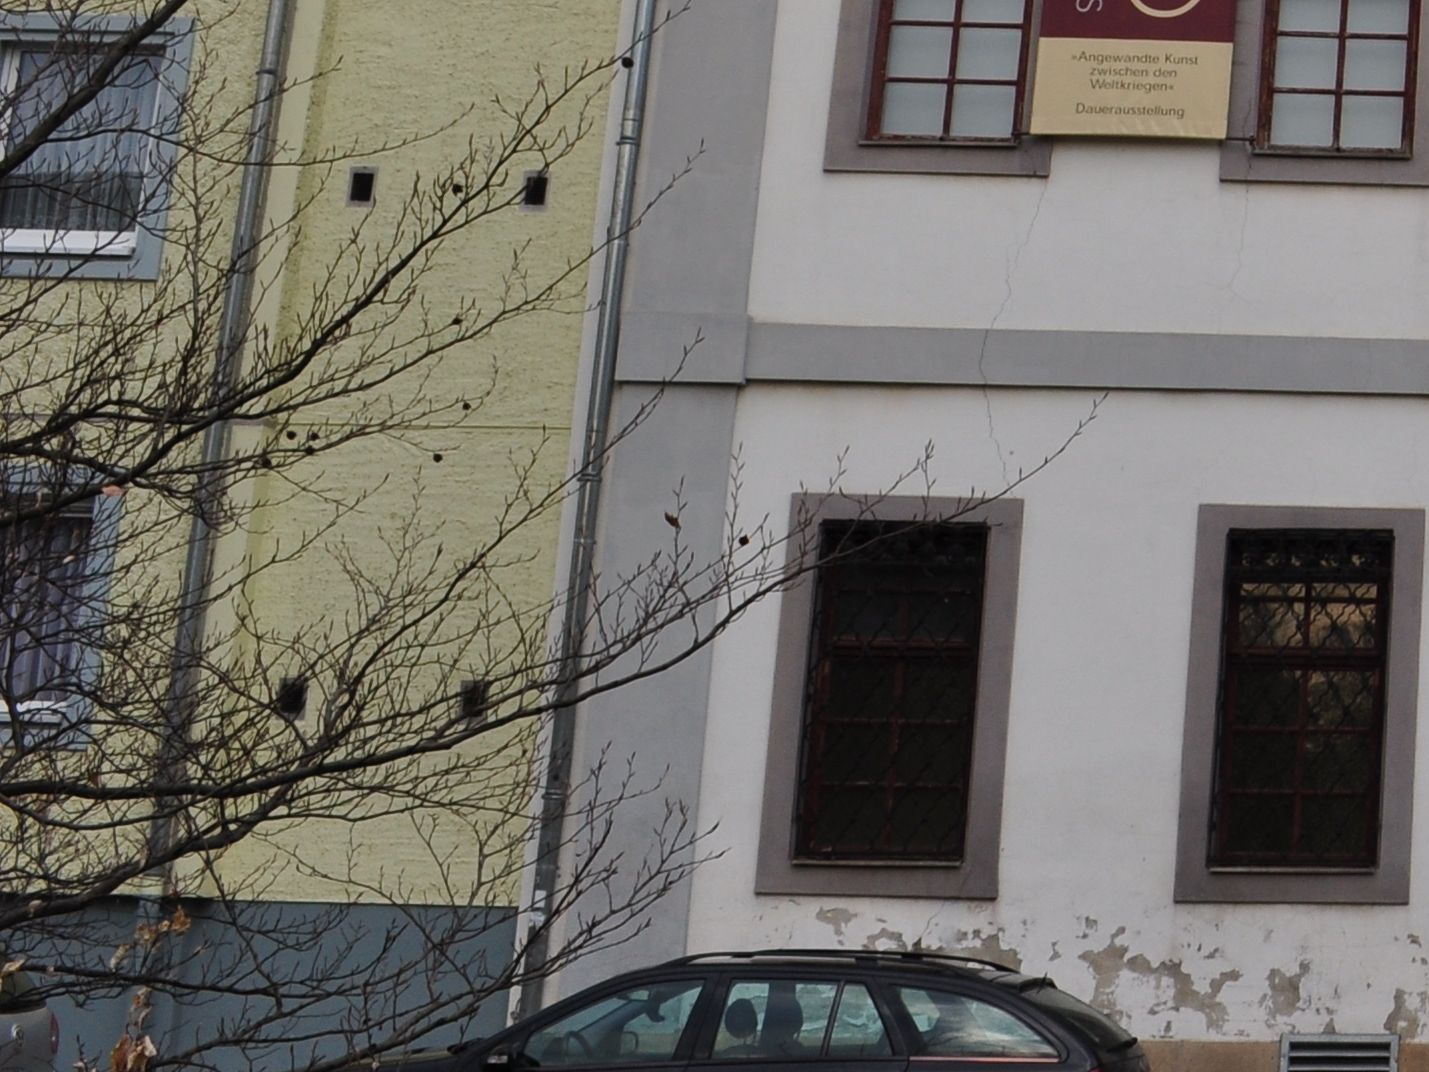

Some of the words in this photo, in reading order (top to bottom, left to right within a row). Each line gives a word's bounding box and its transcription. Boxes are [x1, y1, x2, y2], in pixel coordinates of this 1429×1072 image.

[1164, 52, 1199, 66] Kunst
[1089, 66, 1149, 77] zwischen
[1152, 67, 1178, 78] den
[1075, 102, 1185, 119] Dauerausstellung
